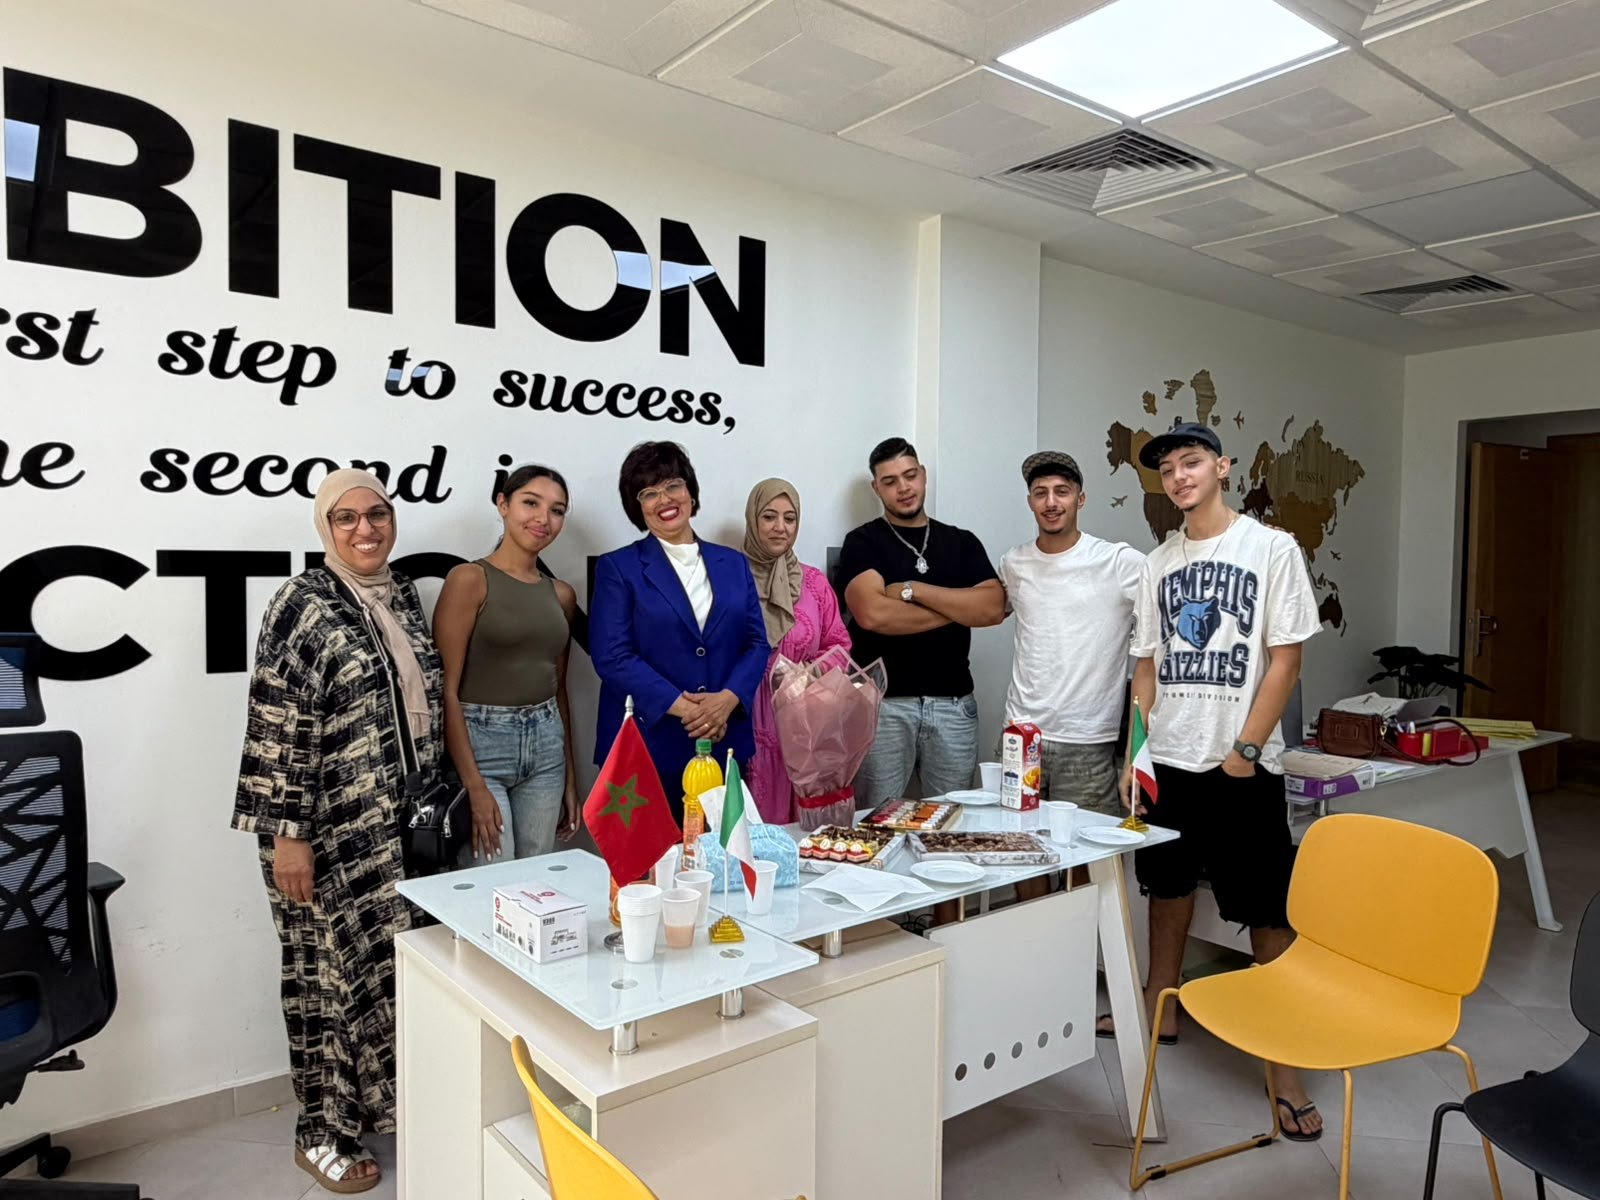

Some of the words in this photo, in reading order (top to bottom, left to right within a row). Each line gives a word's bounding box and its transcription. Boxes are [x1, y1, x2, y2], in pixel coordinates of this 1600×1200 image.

[3, 67, 766, 367] BITION
[0, 307, 104, 366] st
[158, 326, 336, 405] step
[385, 346, 456, 401] to
[493, 368, 736, 435] success,
